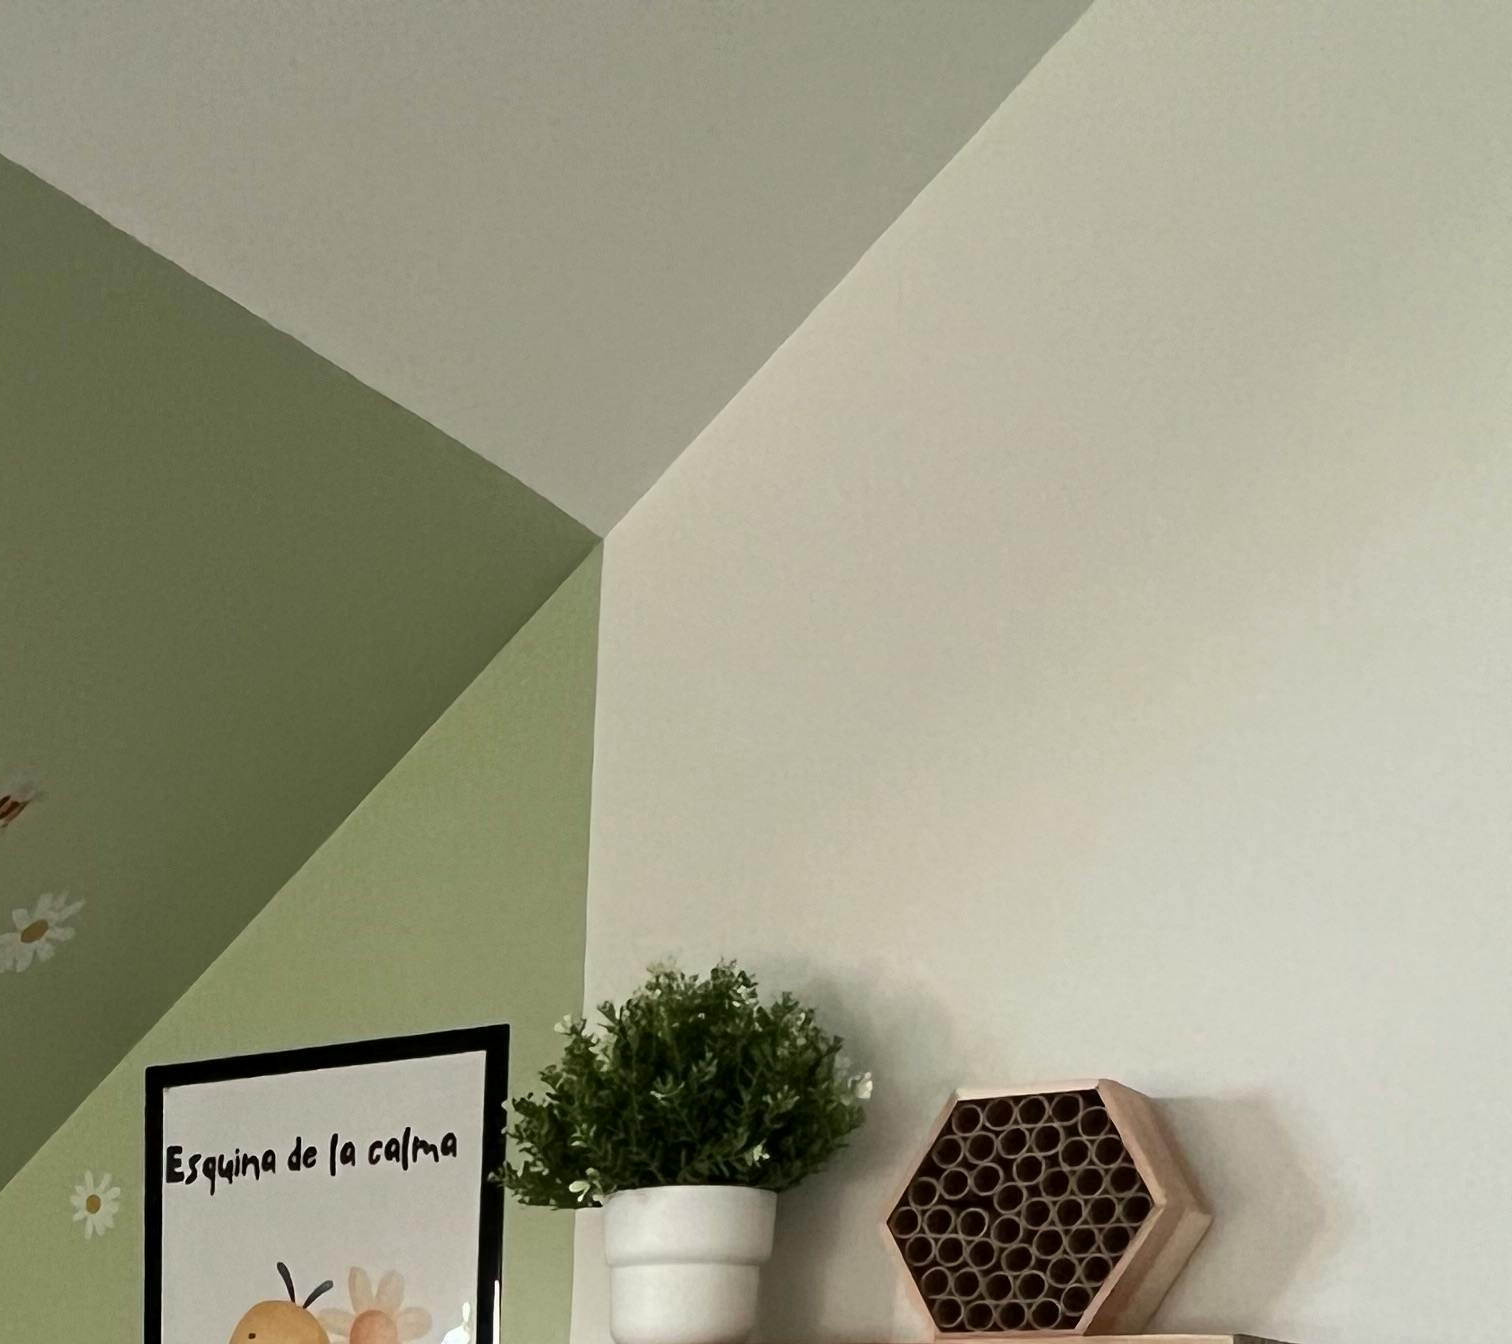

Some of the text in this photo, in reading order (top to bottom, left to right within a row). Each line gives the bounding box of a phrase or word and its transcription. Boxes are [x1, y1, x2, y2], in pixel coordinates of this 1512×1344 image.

[165, 1126, 458, 1196] Esquina de la calma
